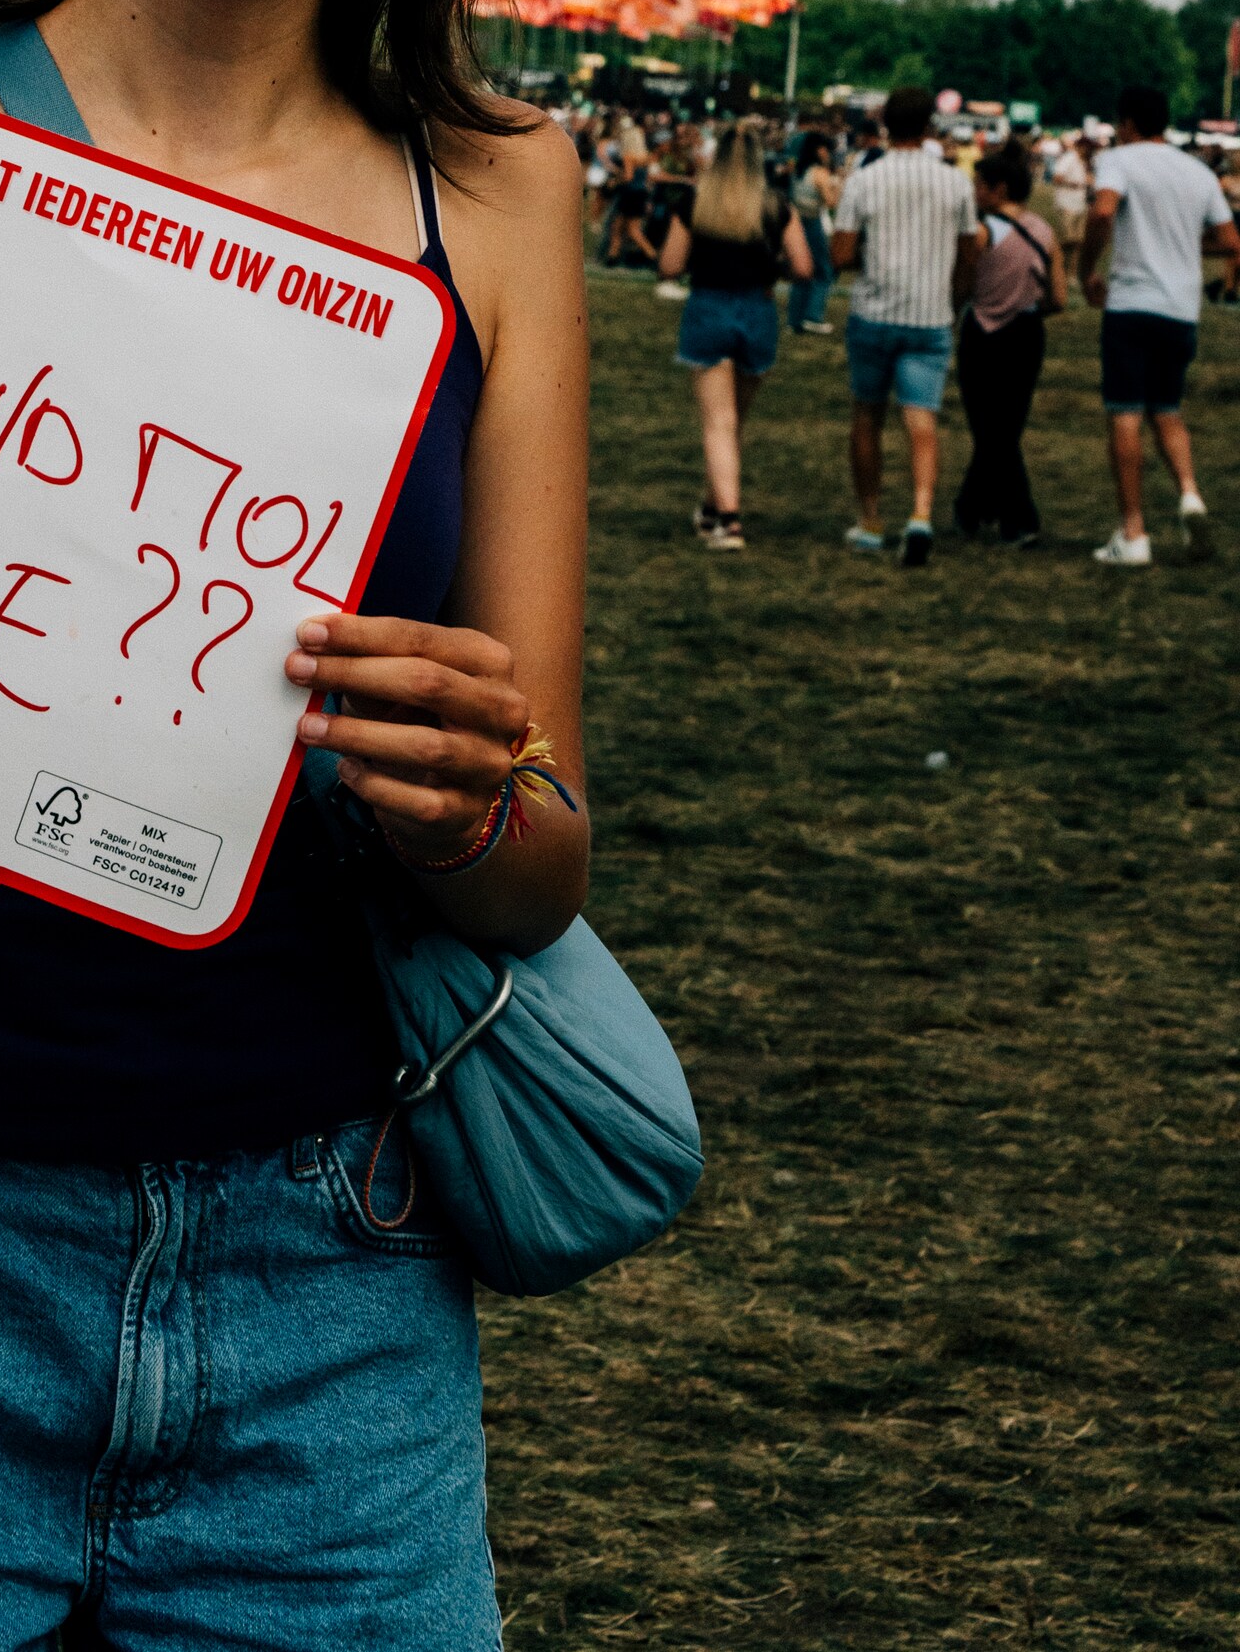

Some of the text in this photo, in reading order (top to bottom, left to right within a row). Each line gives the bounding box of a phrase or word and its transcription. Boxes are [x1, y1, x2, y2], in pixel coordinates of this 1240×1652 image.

[22, 171, 205, 270] IEDEREEN
[208, 238, 276, 294] UW
[276, 263, 394, 339] ONZIN
[32, 837, 70, 856] www.fsc.org
[34, 821, 75, 847] FSC
[141, 824, 168, 843] MIX
[89, 838, 198, 883] verantwoord bosbeheer
[100, 828, 131, 847] Papier
[139, 843, 197, 871] Ondersteunt
[129, 869, 186, 897] C012419
